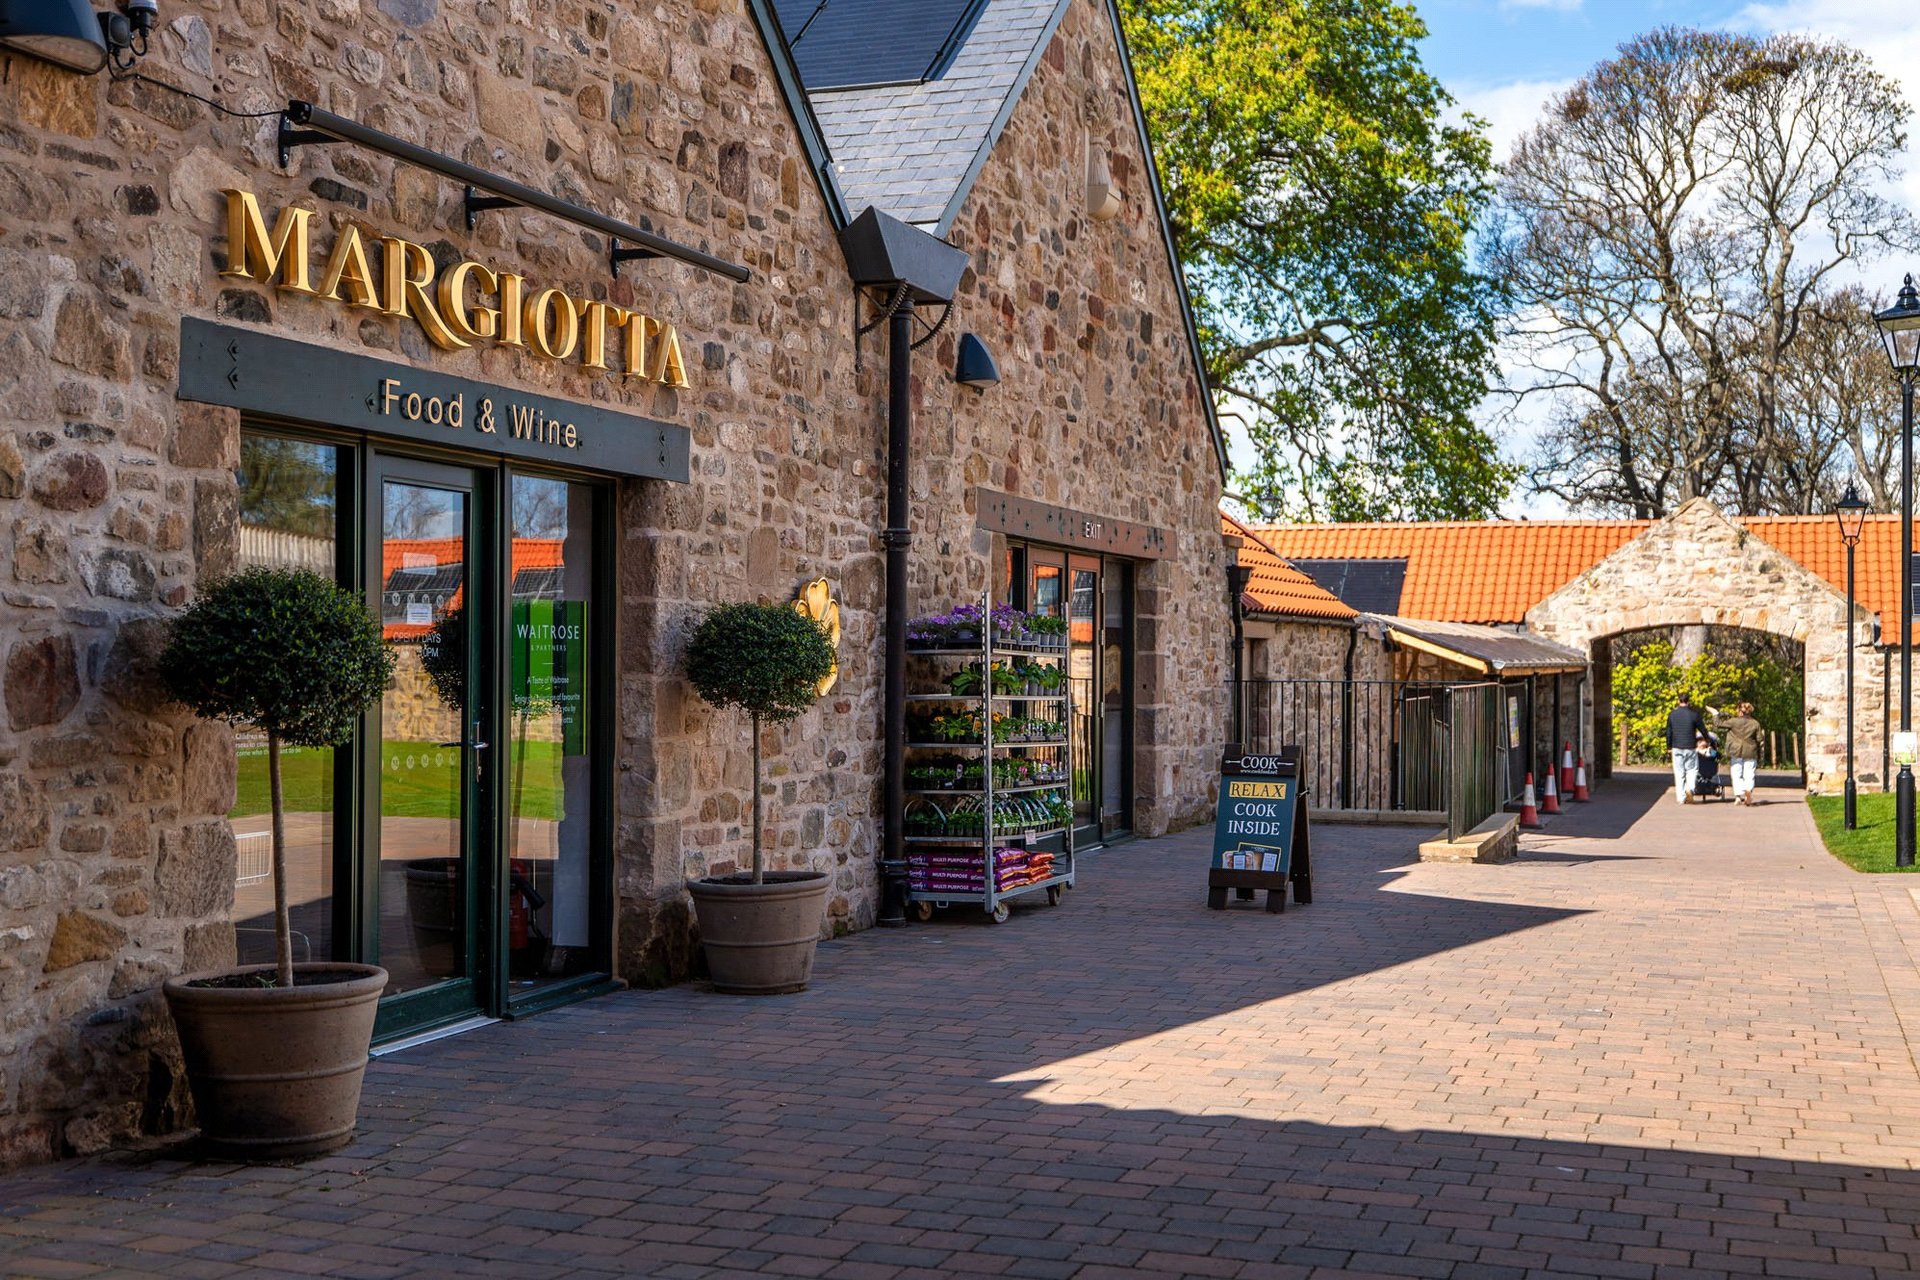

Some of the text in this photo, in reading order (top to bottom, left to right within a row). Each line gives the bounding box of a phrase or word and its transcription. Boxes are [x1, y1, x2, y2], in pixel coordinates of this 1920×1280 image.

[219, 187, 691, 390] MARGIOTTA
[385, 378, 577, 448] Food & Wine
[1085, 522, 1101, 539] EXIT
[393, 632, 415, 642] OPEN
[422, 633, 441, 643] DAYS
[517, 624, 580, 639] WAITROSE
[1241, 756, 1278, 769] COOK
[1231, 783, 1284, 797] RELAX
[1234, 803, 1277, 817] COOK
[1228, 820, 1280, 835] INSIDE
